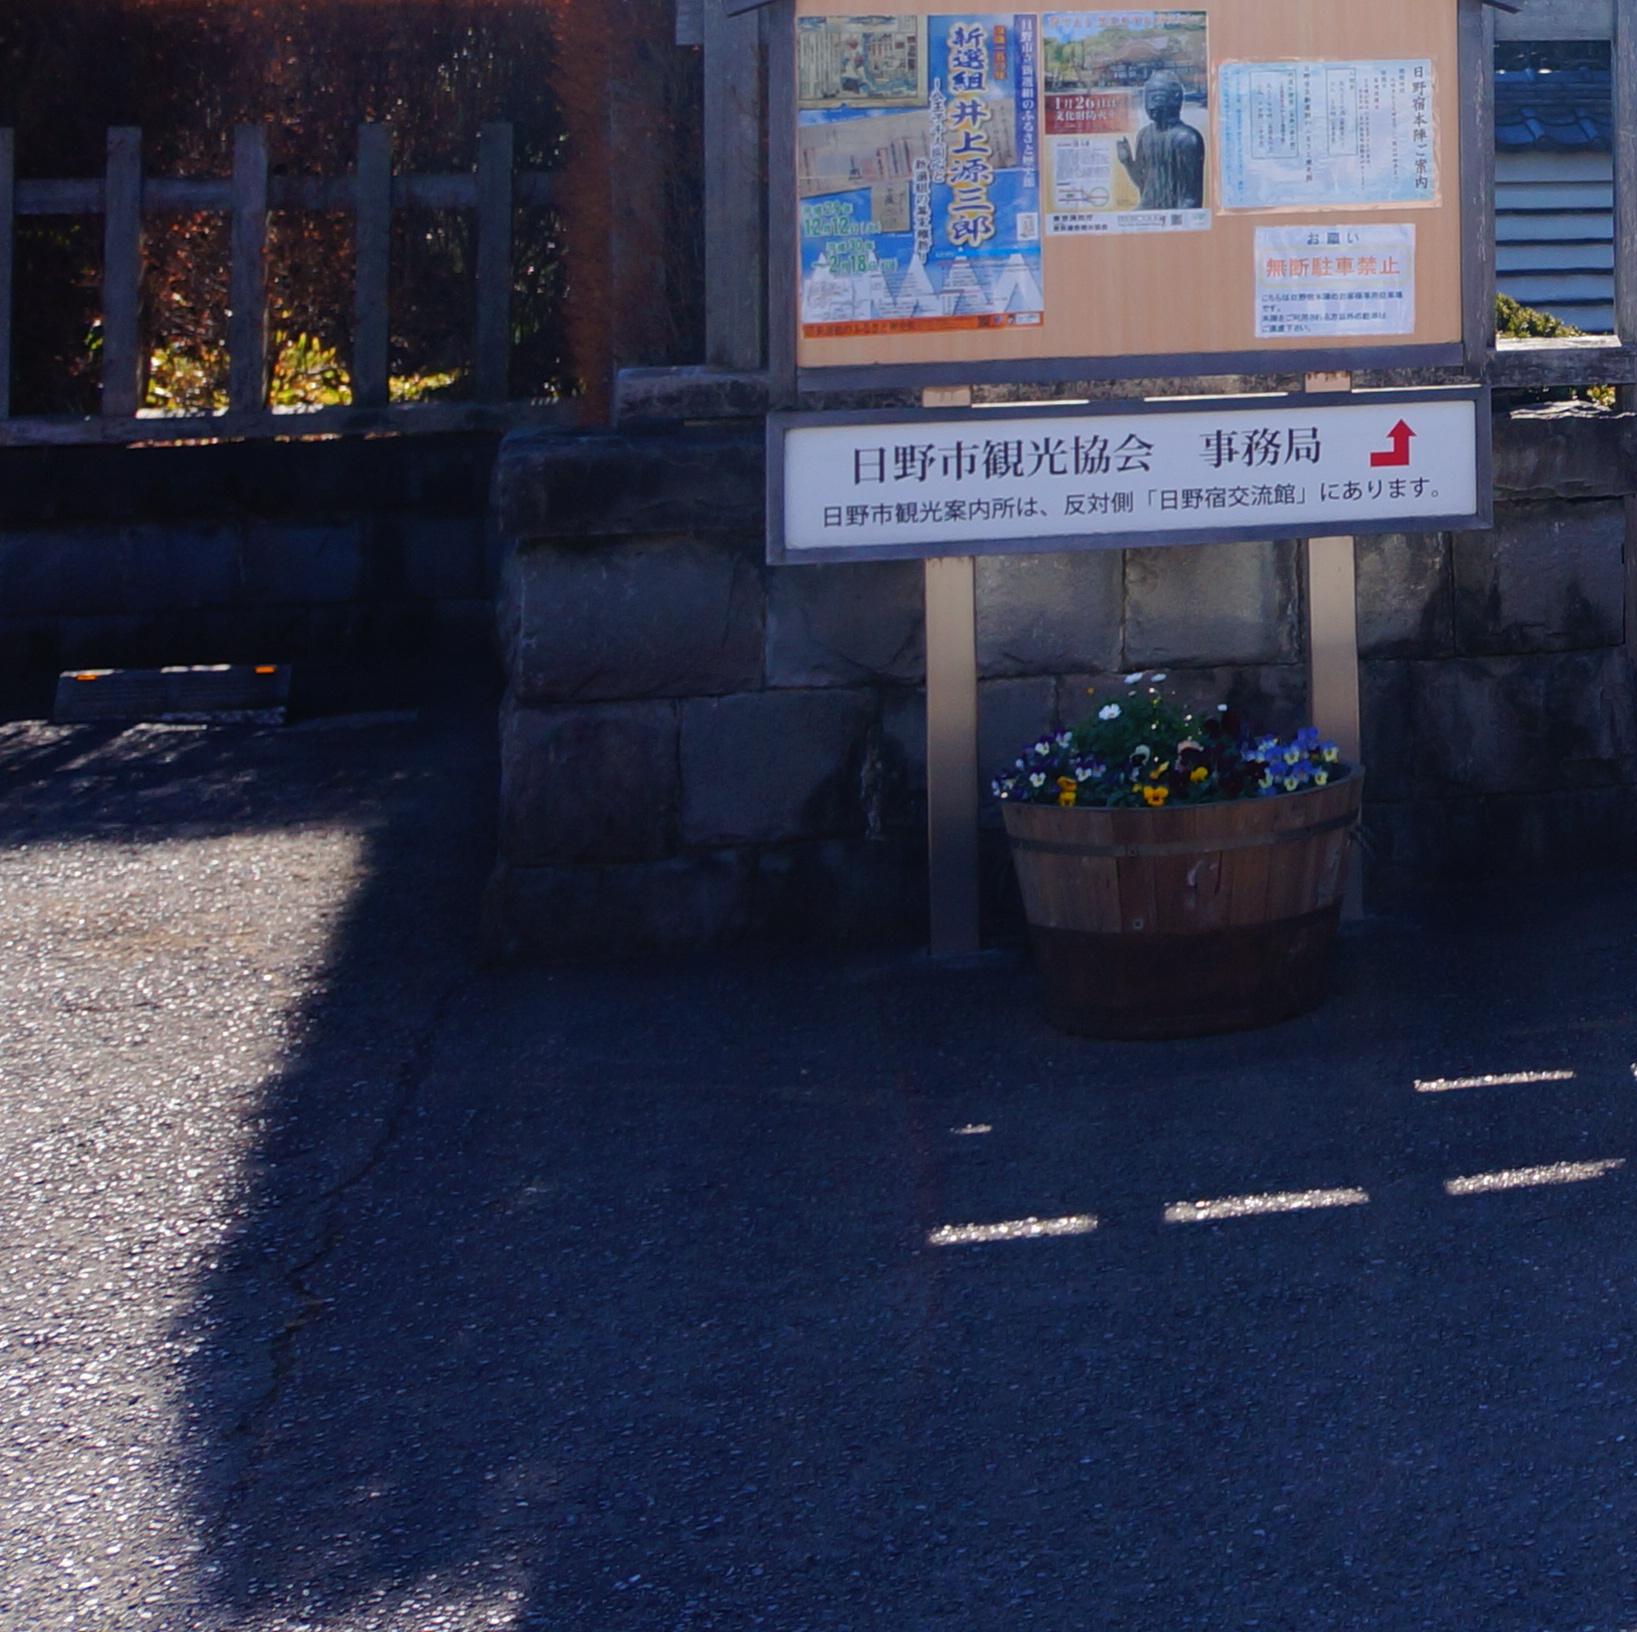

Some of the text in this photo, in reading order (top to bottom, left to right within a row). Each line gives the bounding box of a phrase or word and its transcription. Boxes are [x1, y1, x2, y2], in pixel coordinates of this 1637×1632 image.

[1411, 65, 1429, 190] 日野宿本陣ご案内
[1306, 232, 1360, 246] お願い
[1265, 256, 1401, 278] 無断駐車禁止
[853, 427, 1322, 486] 日野市観光協会 事務局
[821, 476, 1441, 529] 日野市観光案内所は、反対側「日野宿交流館」にあります。
